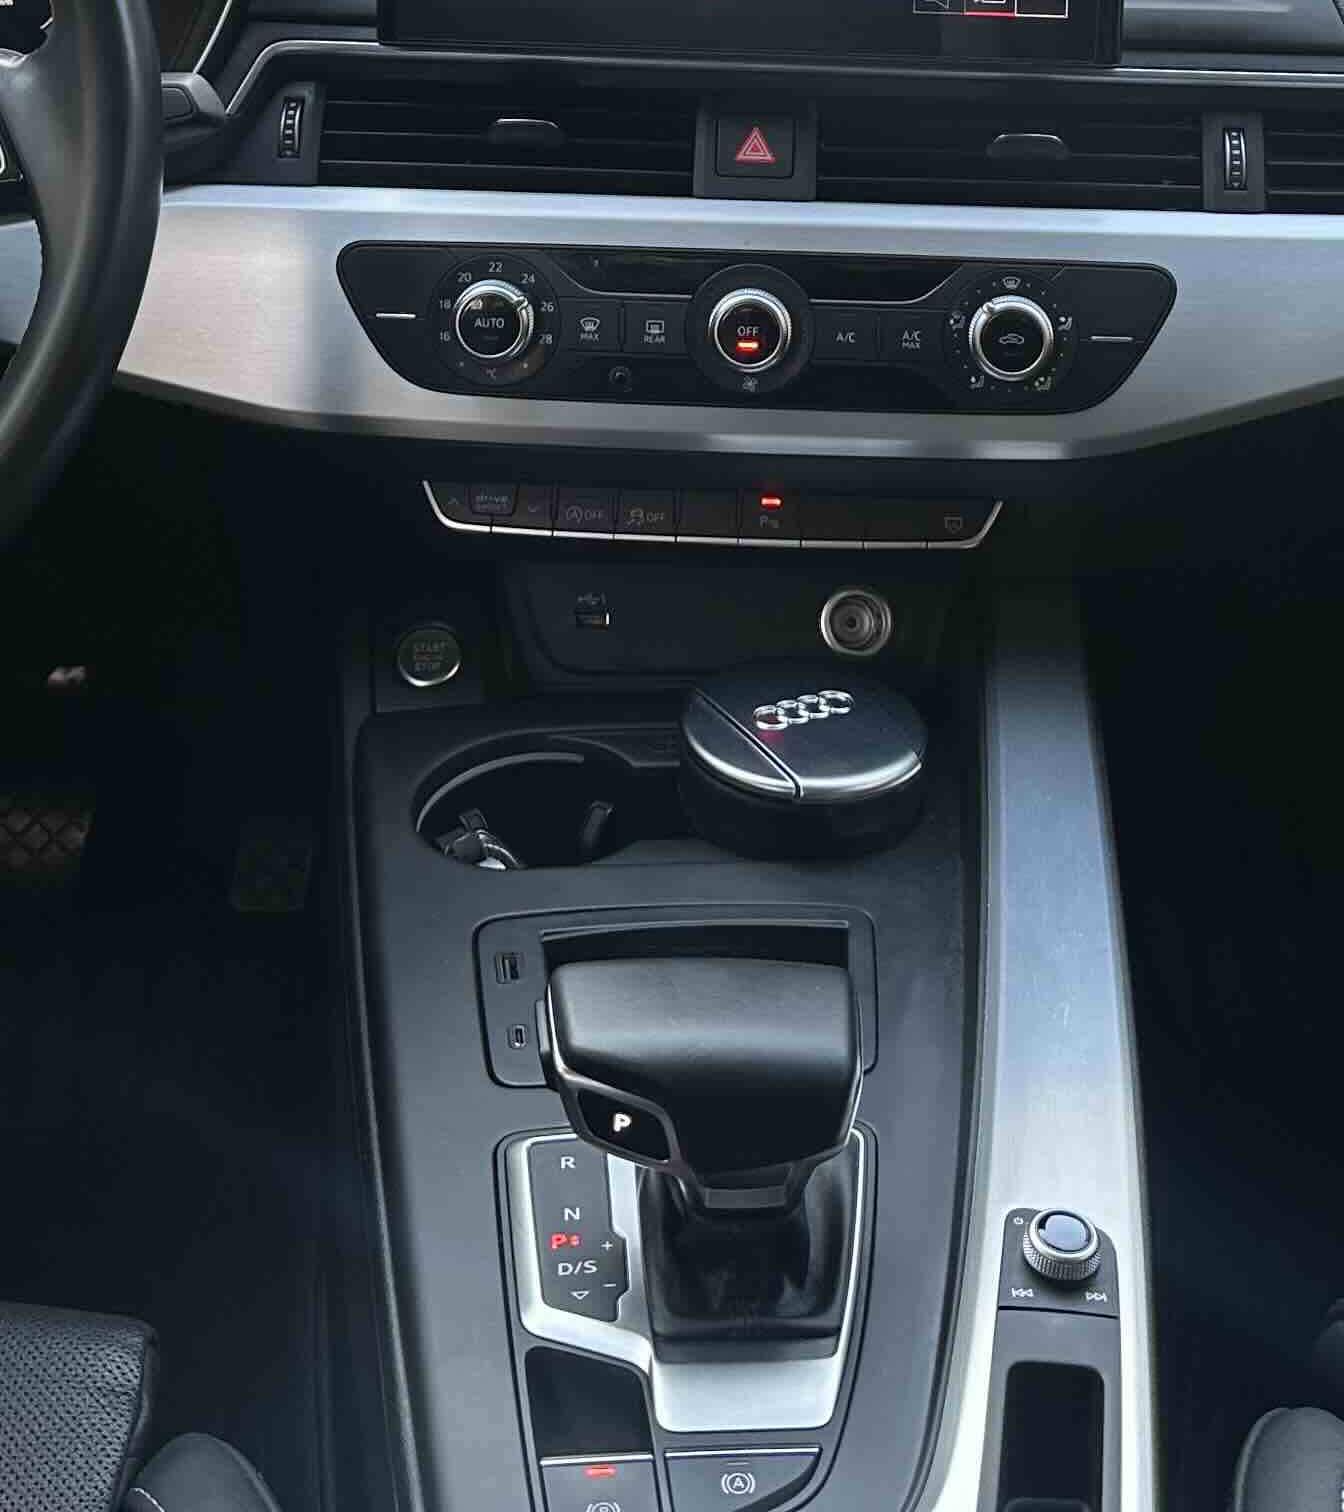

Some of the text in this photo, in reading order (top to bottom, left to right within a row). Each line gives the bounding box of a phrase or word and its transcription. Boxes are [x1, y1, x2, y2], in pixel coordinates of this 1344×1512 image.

[488, 262, 503, 272] 22
[457, 273, 471, 282] 20
[521, 273, 535, 283] 24
[541, 302, 554, 312] 26
[474, 318, 504, 328] AUTO
[440, 331, 450, 341] 16
[737, 327, 759, 336] OFF
[902, 330, 920, 342] A/C
[539, 334, 552, 344] 28
[836, 332, 856, 343] A/C
[613, 1114, 632, 1132] P
[560, 1156, 576, 1169] R
[564, 1207, 581, 1221] N
[558, 1260, 598, 1275] D/S
